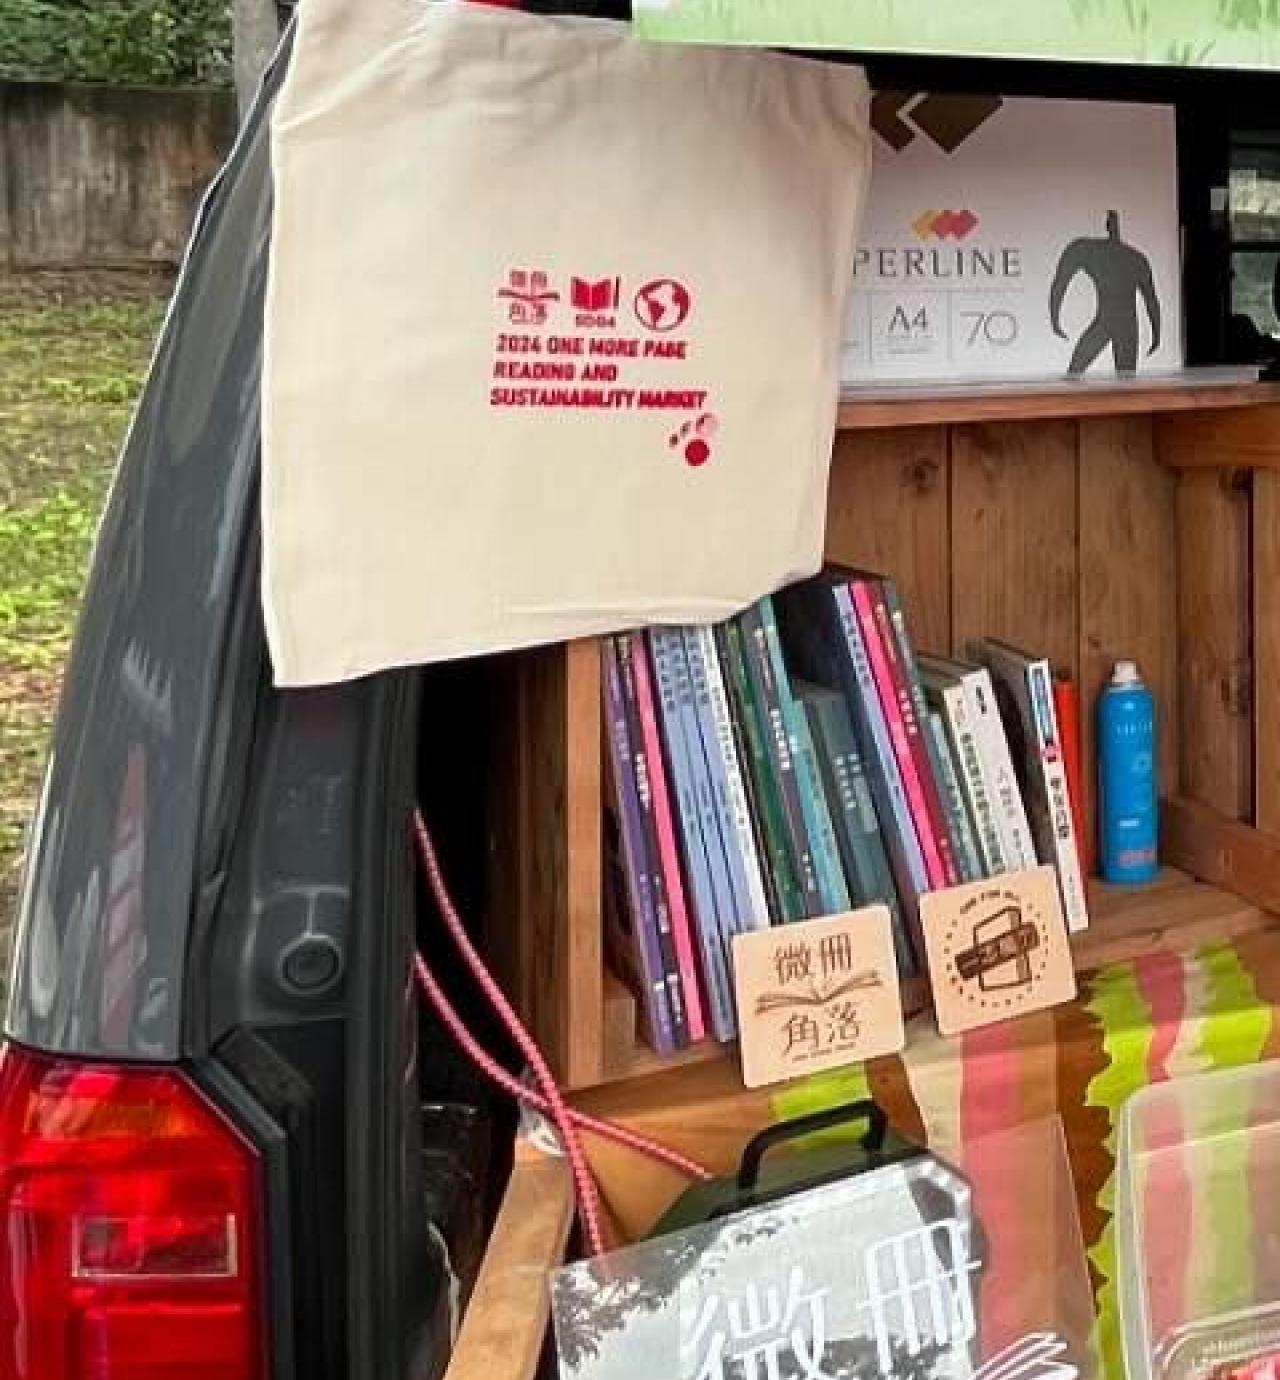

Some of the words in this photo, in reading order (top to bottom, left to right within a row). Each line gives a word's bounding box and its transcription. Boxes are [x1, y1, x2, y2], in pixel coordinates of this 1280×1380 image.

[852, 247, 1022, 278] PERLINE
[887, 305, 929, 331] A4
[959, 310, 1017, 346] 70
[497, 333, 542, 352] 2024
[547, 337, 585, 355] ONE
[589, 337, 640, 358] MORE
[493, 361, 577, 379] READING
[581, 363, 618, 382] AND
[490, 387, 636, 408] SUSTAINABILITY
[637, 390, 708, 410] MARKET
[774, 931, 852, 986] 微冊
[780, 1000, 862, 1054] 角落
